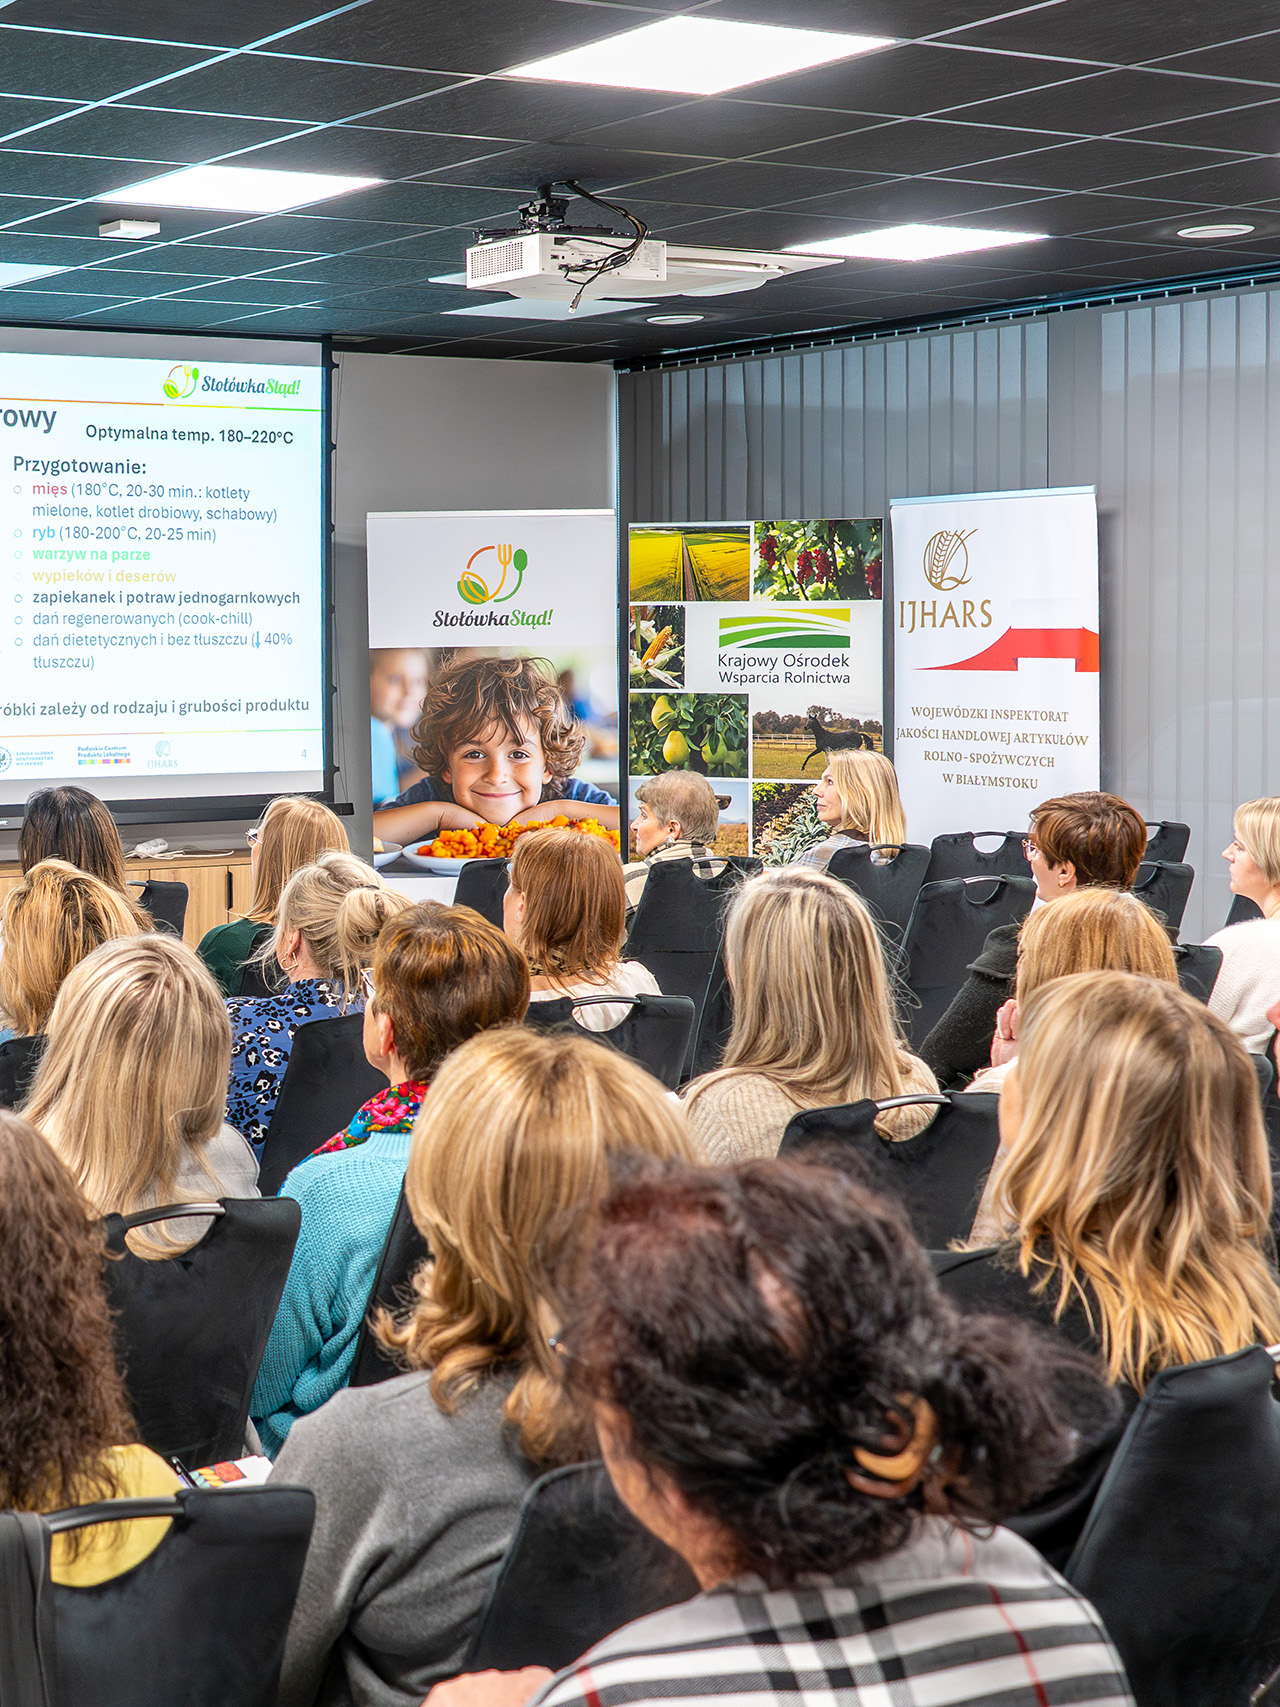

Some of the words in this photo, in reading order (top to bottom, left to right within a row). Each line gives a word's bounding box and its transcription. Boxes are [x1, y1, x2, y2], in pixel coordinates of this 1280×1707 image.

[202, 376, 301, 398] StołówkaStąd!
[86, 425, 168, 441] Optymalna
[172, 429, 214, 444] temp.
[14, 456, 146, 476] Przygotowanie:
[33, 482, 67, 497] mięs
[72, 482, 122, 498] (180°C,
[127, 484, 164, 497] 20-30
[169, 485, 201, 498] min.:
[206, 486, 250, 502] kotlety
[33, 504, 92, 519] mielone,
[97, 505, 134, 518] kotlet
[139, 506, 202, 522] drobiowy,
[207, 508, 277, 523] schabowy)
[33, 526, 55, 541] ryb
[60, 526, 141, 541] (180-200°C,
[145, 527, 183, 540] 20-25
[187, 528, 216, 543] min)
[32, 550, 87, 563] warzyw
[90, 550, 107, 560] na
[112, 551, 150, 563] parze
[33, 569, 104, 584] wypieków
[109, 570, 111, 582] i
[116, 570, 176, 582] deserów
[33, 590, 115, 606] zapiekanek
[120, 591, 122, 603] i
[127, 592, 175, 606] potraw
[178, 591, 300, 606] jednogarnkowych
[33, 611, 58, 624] dań
[63, 612, 174, 628] regenerowanych
[179, 612, 252, 627] (cook-chill)
[433, 609, 553, 629] StołówkaStąd!
[900, 600, 992, 633] IJHARS
[34, 633, 59, 646] dań
[63, 633, 156, 649] dietetycznych
[161, 633, 163, 645] i
[168, 634, 190, 645] bez
[194, 633, 247, 645] tłuszczu
[265, 633, 292, 645] 40%
[33, 656, 94, 670] tłuszczu)
[719, 654, 778, 671] Krajowy
[783, 653, 849, 667] Ośrodek
[719, 670, 779, 686] Wsparcia
[785, 671, 850, 684] Rolnictwa
[40, 702, 86, 718] zależy
[91, 702, 108, 714] od
[114, 700, 167, 716] rodzaju
[172, 700, 175, 713] i
[179, 699, 241, 716] grubości
[246, 699, 309, 714] produktu
[911, 705, 987, 720] WOJEWÓDZKI
[991, 709, 1068, 722] INSPEKTORAT
[896, 726, 938, 740] JAKOŚCI
[942, 730, 1010, 745] HANDLOWEJ
[1014, 733, 1088, 745] ARTYKUŁÓW
[301, 749, 307, 758] 4
[924, 751, 1054, 767] ROLNO-SPOŻYWCZYCH
[148, 759, 178, 769] IJHARS
[942, 774, 953, 783] W
[956, 774, 1038, 789] BIAŁYMSTOKU
